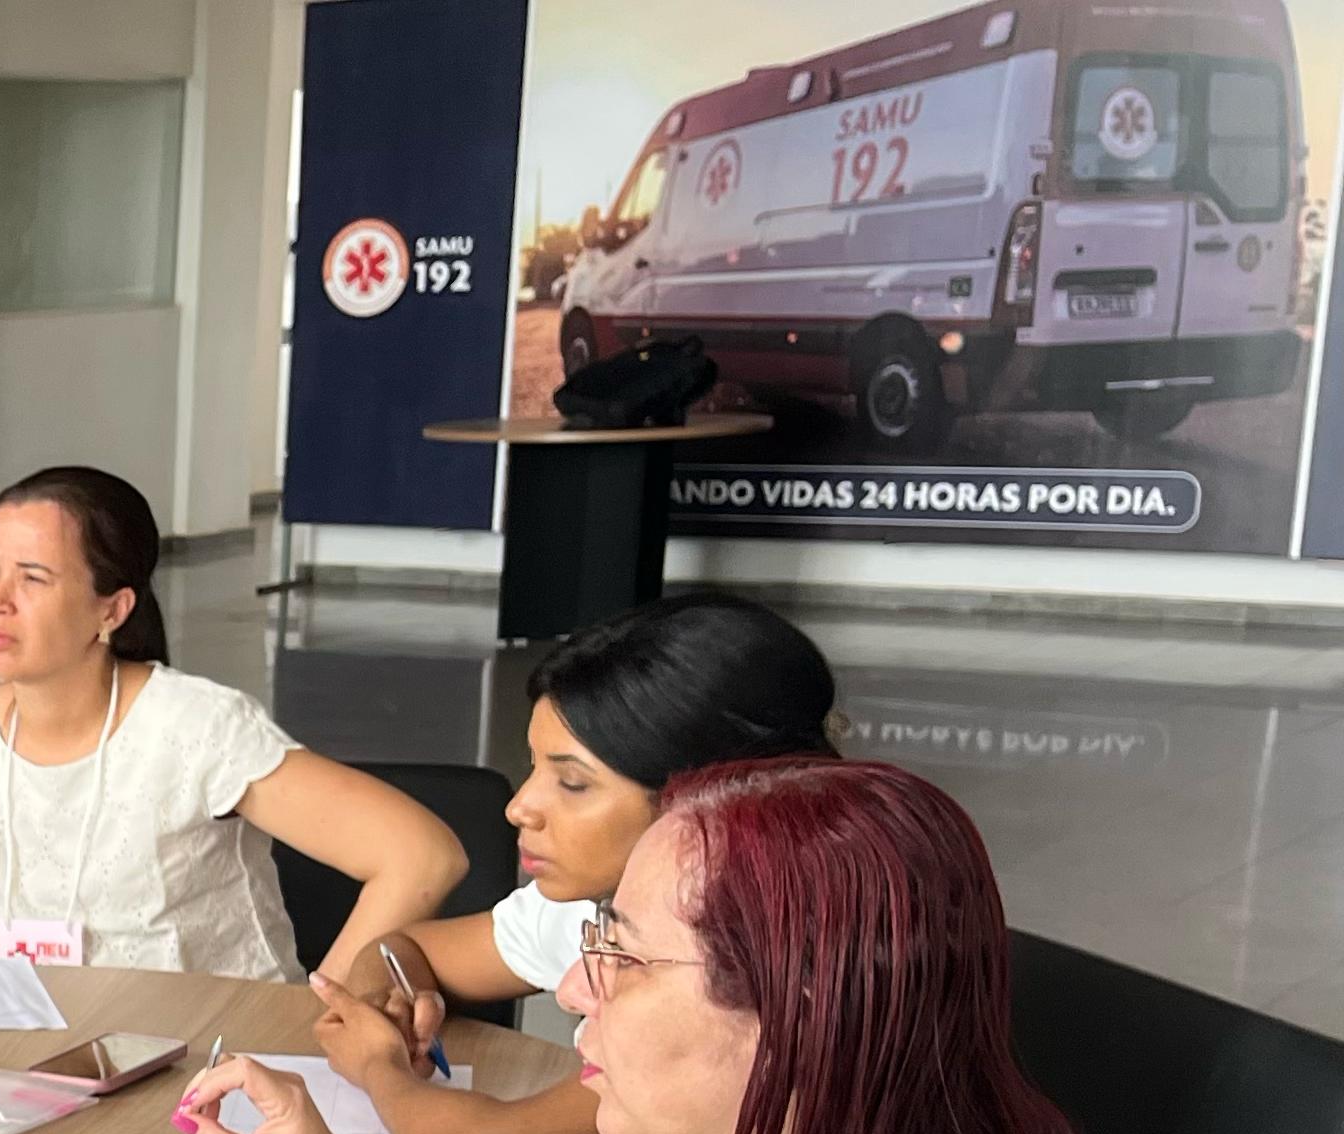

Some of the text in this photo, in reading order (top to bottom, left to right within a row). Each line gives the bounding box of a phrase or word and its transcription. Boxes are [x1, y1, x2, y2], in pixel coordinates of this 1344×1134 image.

[835, 92, 923, 140] SAMU
[831, 136, 909, 208] 192
[415, 236, 473, 257] SAMU
[413, 260, 472, 292] 192
[762, 480, 855, 509] VIDAS
[859, 481, 898, 510] 24
[903, 481, 1021, 513] HORAS
[1027, 484, 1100, 515] POR
[1107, 486, 1176, 516] DIA.
